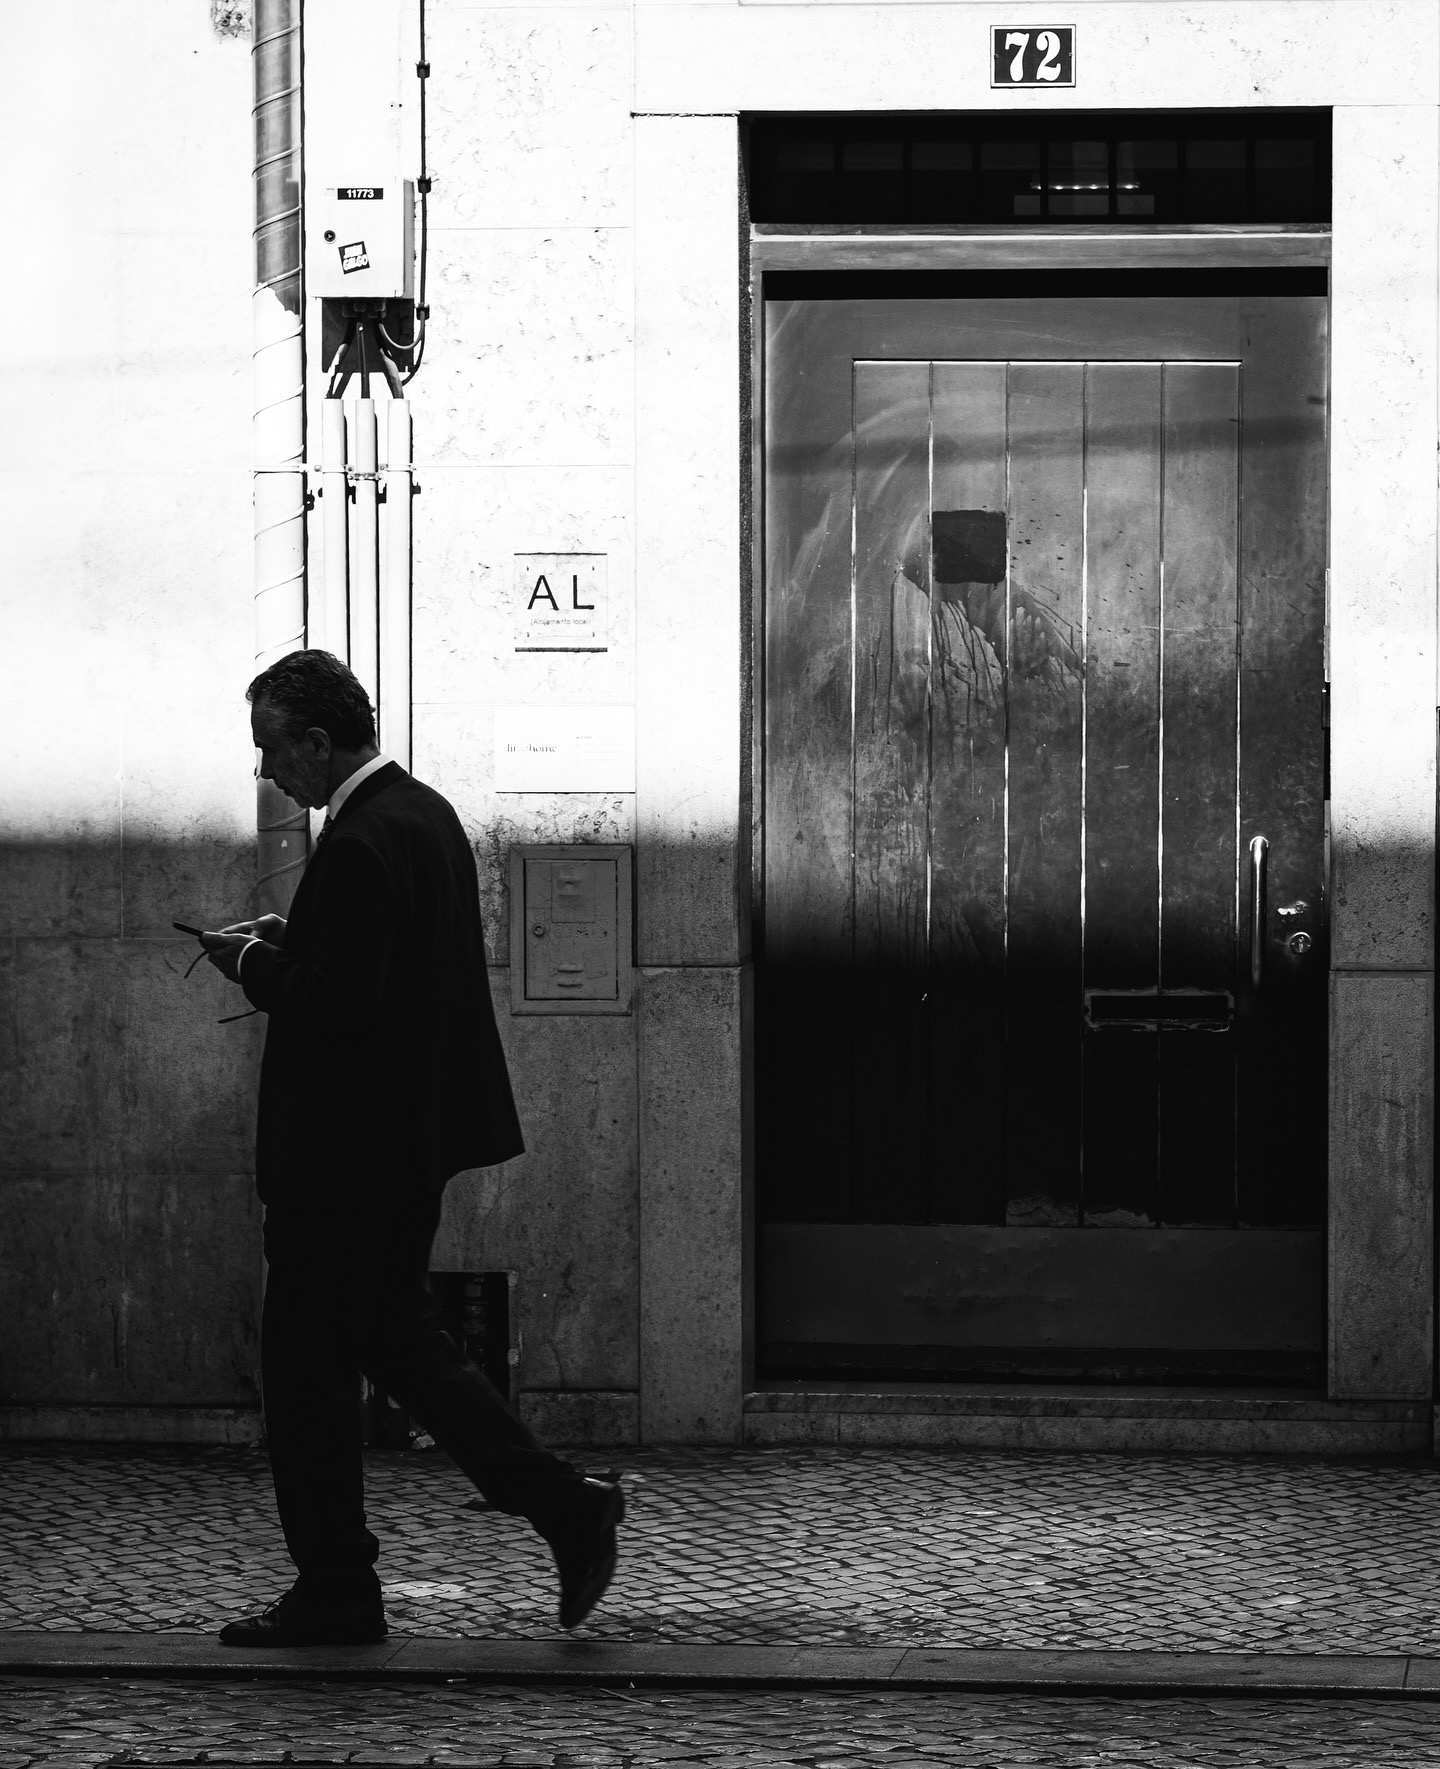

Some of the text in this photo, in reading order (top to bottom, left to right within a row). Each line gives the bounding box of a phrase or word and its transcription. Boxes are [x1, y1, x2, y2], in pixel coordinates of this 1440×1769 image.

[1004, 30, 1062, 82] 72
[346, 188, 375, 199] 11773
[507, 743, 558, 753] lihome
